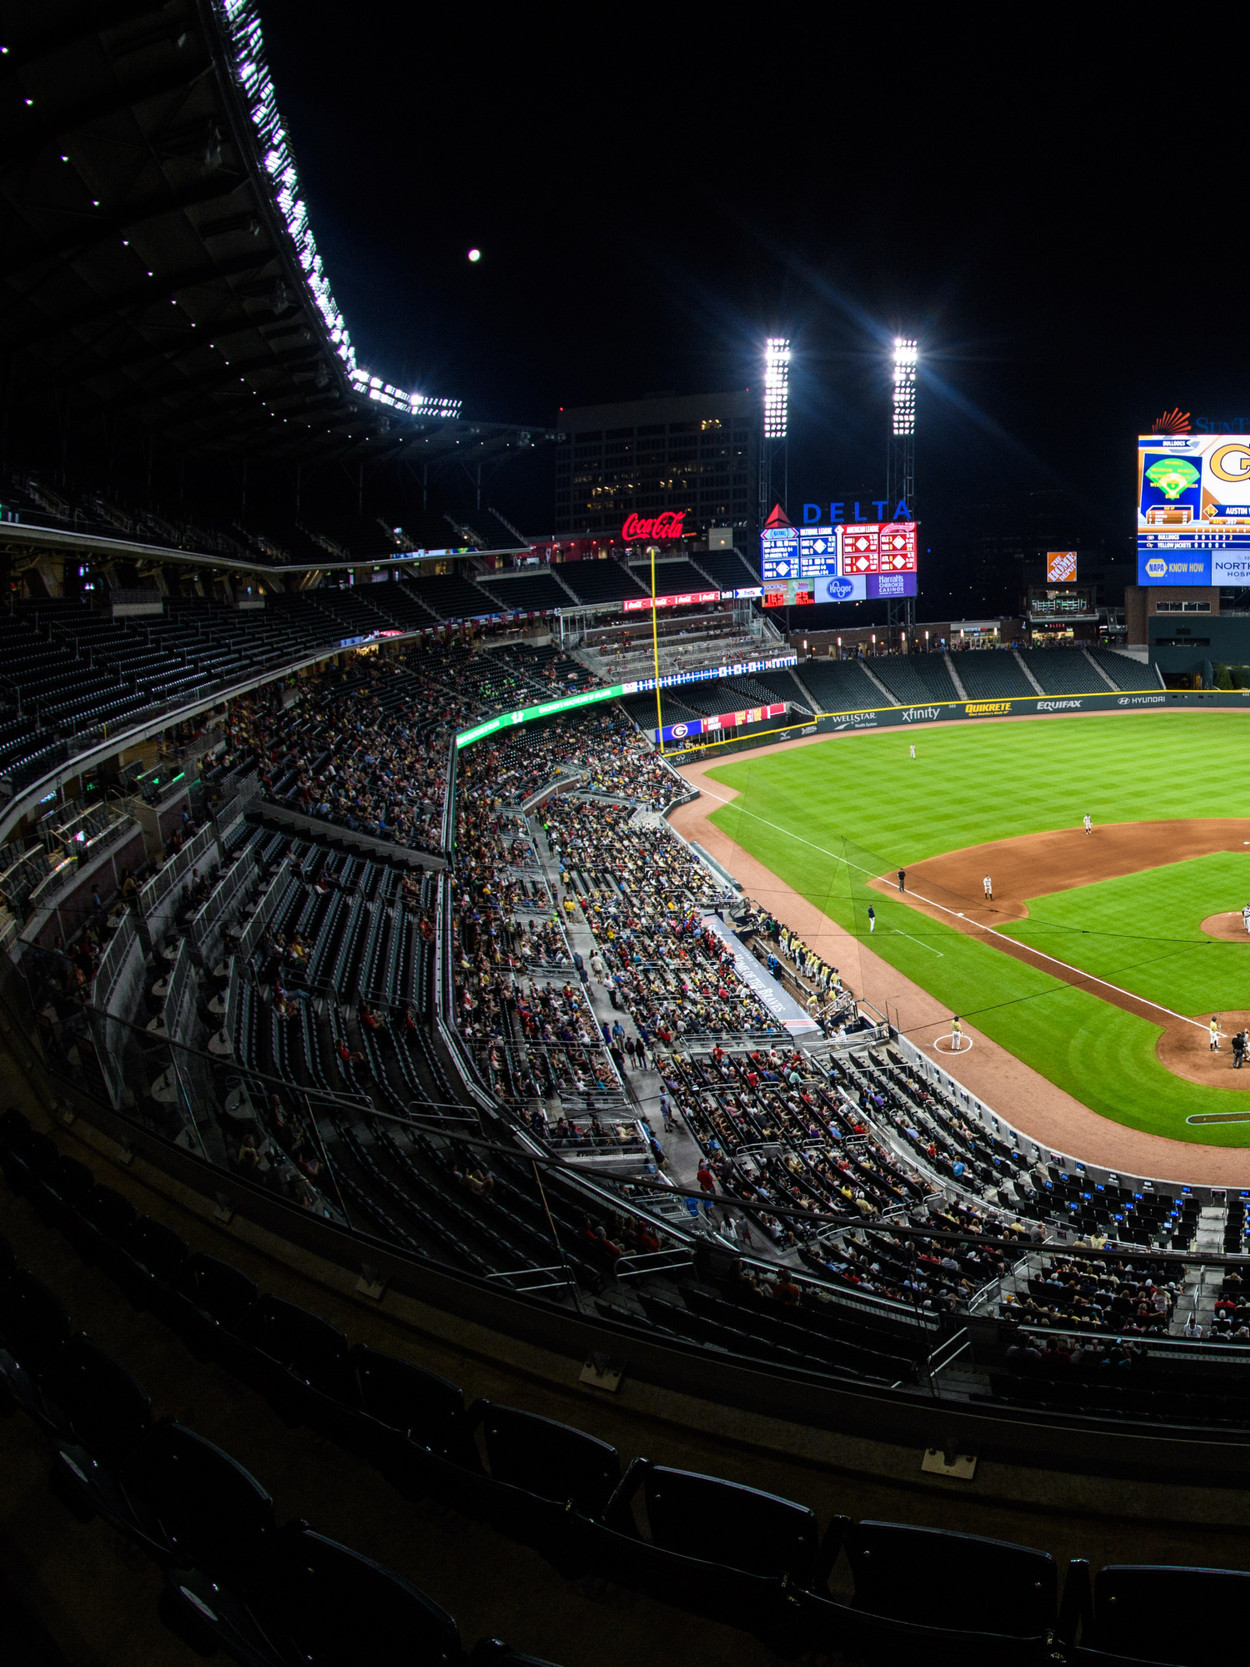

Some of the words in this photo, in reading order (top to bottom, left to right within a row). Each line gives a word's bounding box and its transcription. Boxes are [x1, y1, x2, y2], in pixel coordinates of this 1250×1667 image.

[803, 500, 912, 524] DELTA
[1048, 552, 1076, 581] HOME
[1148, 564, 1164, 572] NAPA
[1168, 563, 1188, 572] KNOW
[1189, 563, 1204, 572] HOW
[830, 581, 851, 598] Kroger
[965, 702, 1011, 713] QUIKRETE
[1036, 700, 1082, 711] EQUIFAX
[1131, 696, 1165, 704] HYUNDAI
[902, 706, 940, 722] xfinity
[758, 988, 786, 1013] BRAVES
